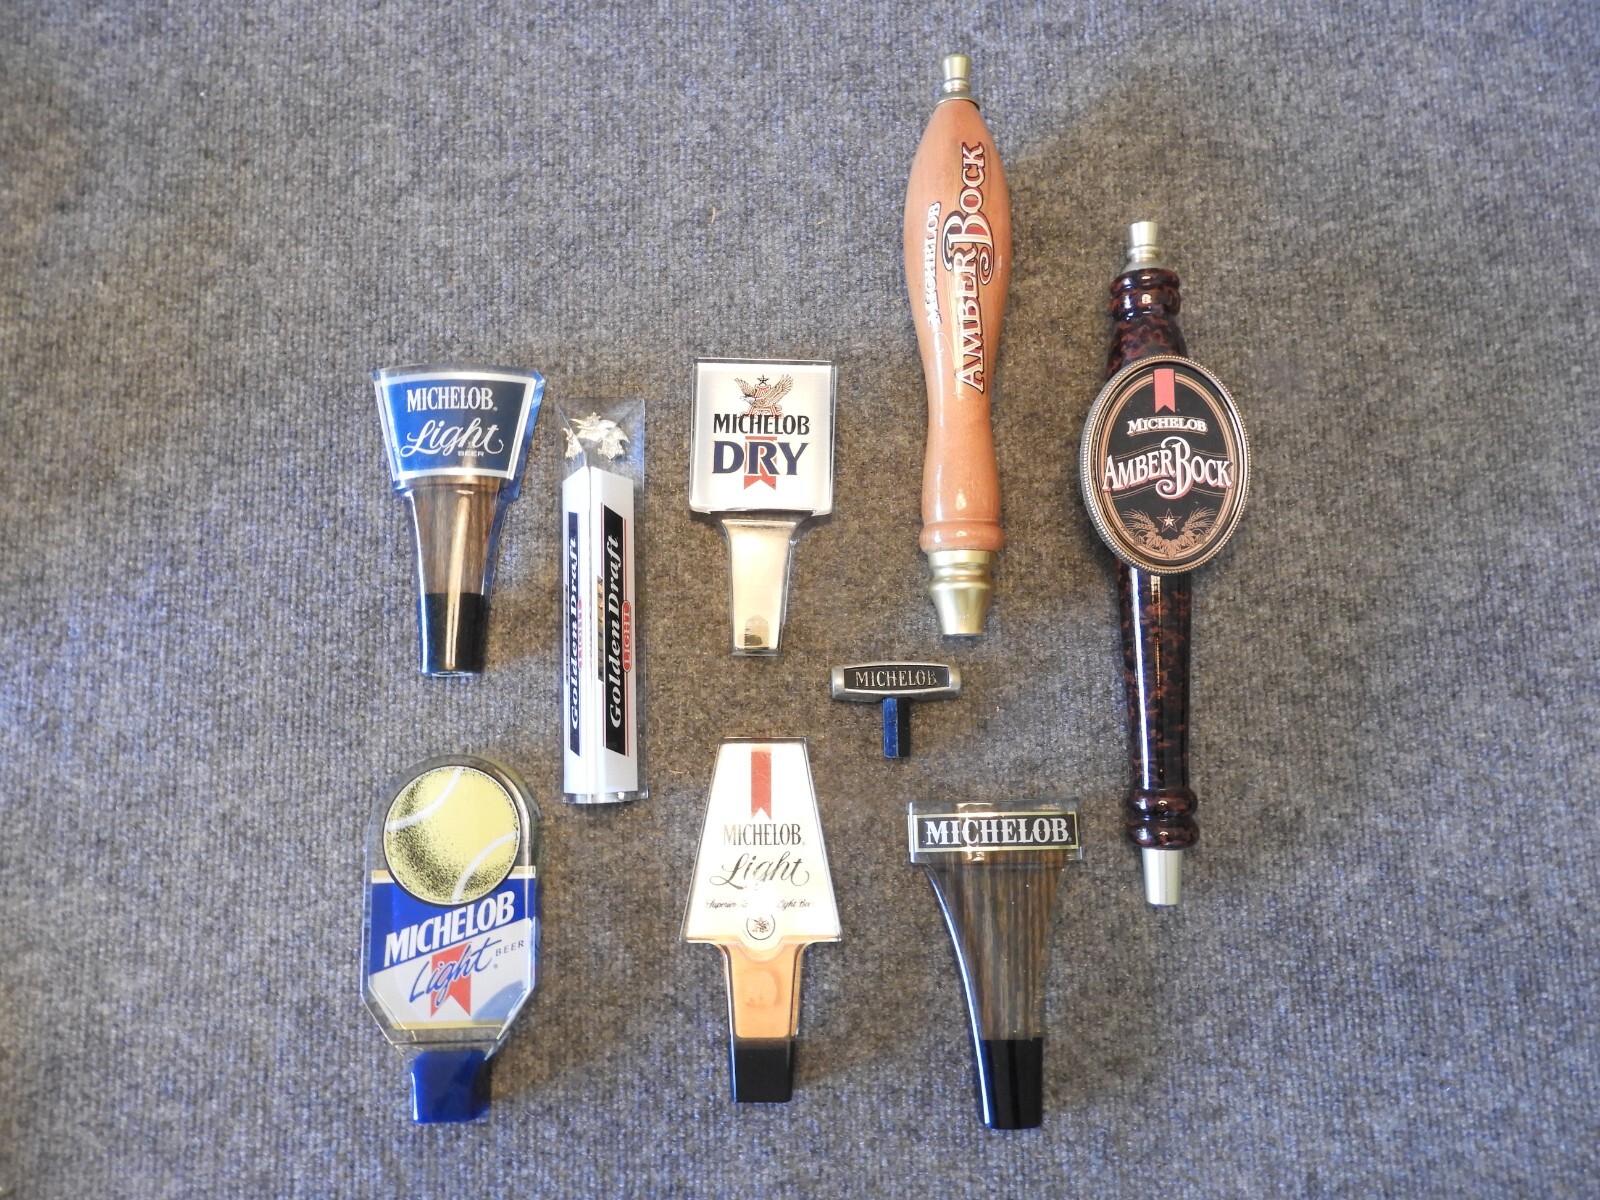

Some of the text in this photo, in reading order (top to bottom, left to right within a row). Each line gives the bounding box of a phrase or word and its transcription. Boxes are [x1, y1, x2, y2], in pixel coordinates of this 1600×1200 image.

[924, 201, 942, 326] MICHELOB
[407, 386, 494, 412] MICHELOB
[400, 417, 504, 458] Light
[713, 413, 810, 436] MICHELOB
[1126, 417, 1208, 436] MICHELOB
[457, 450, 484, 458] BEER
[712, 440, 810, 476] DRY
[623, 607, 631, 664] LIGHT
[855, 670, 938, 687] MICHELOB
[723, 823, 802, 846] MICHELOB
[925, 818, 1069, 846] MICHELOB
[709, 851, 810, 890] Light
[384, 890, 516, 968] MICHELOB
[495, 939, 525, 957] BEER
[409, 937, 503, 1007] Light
